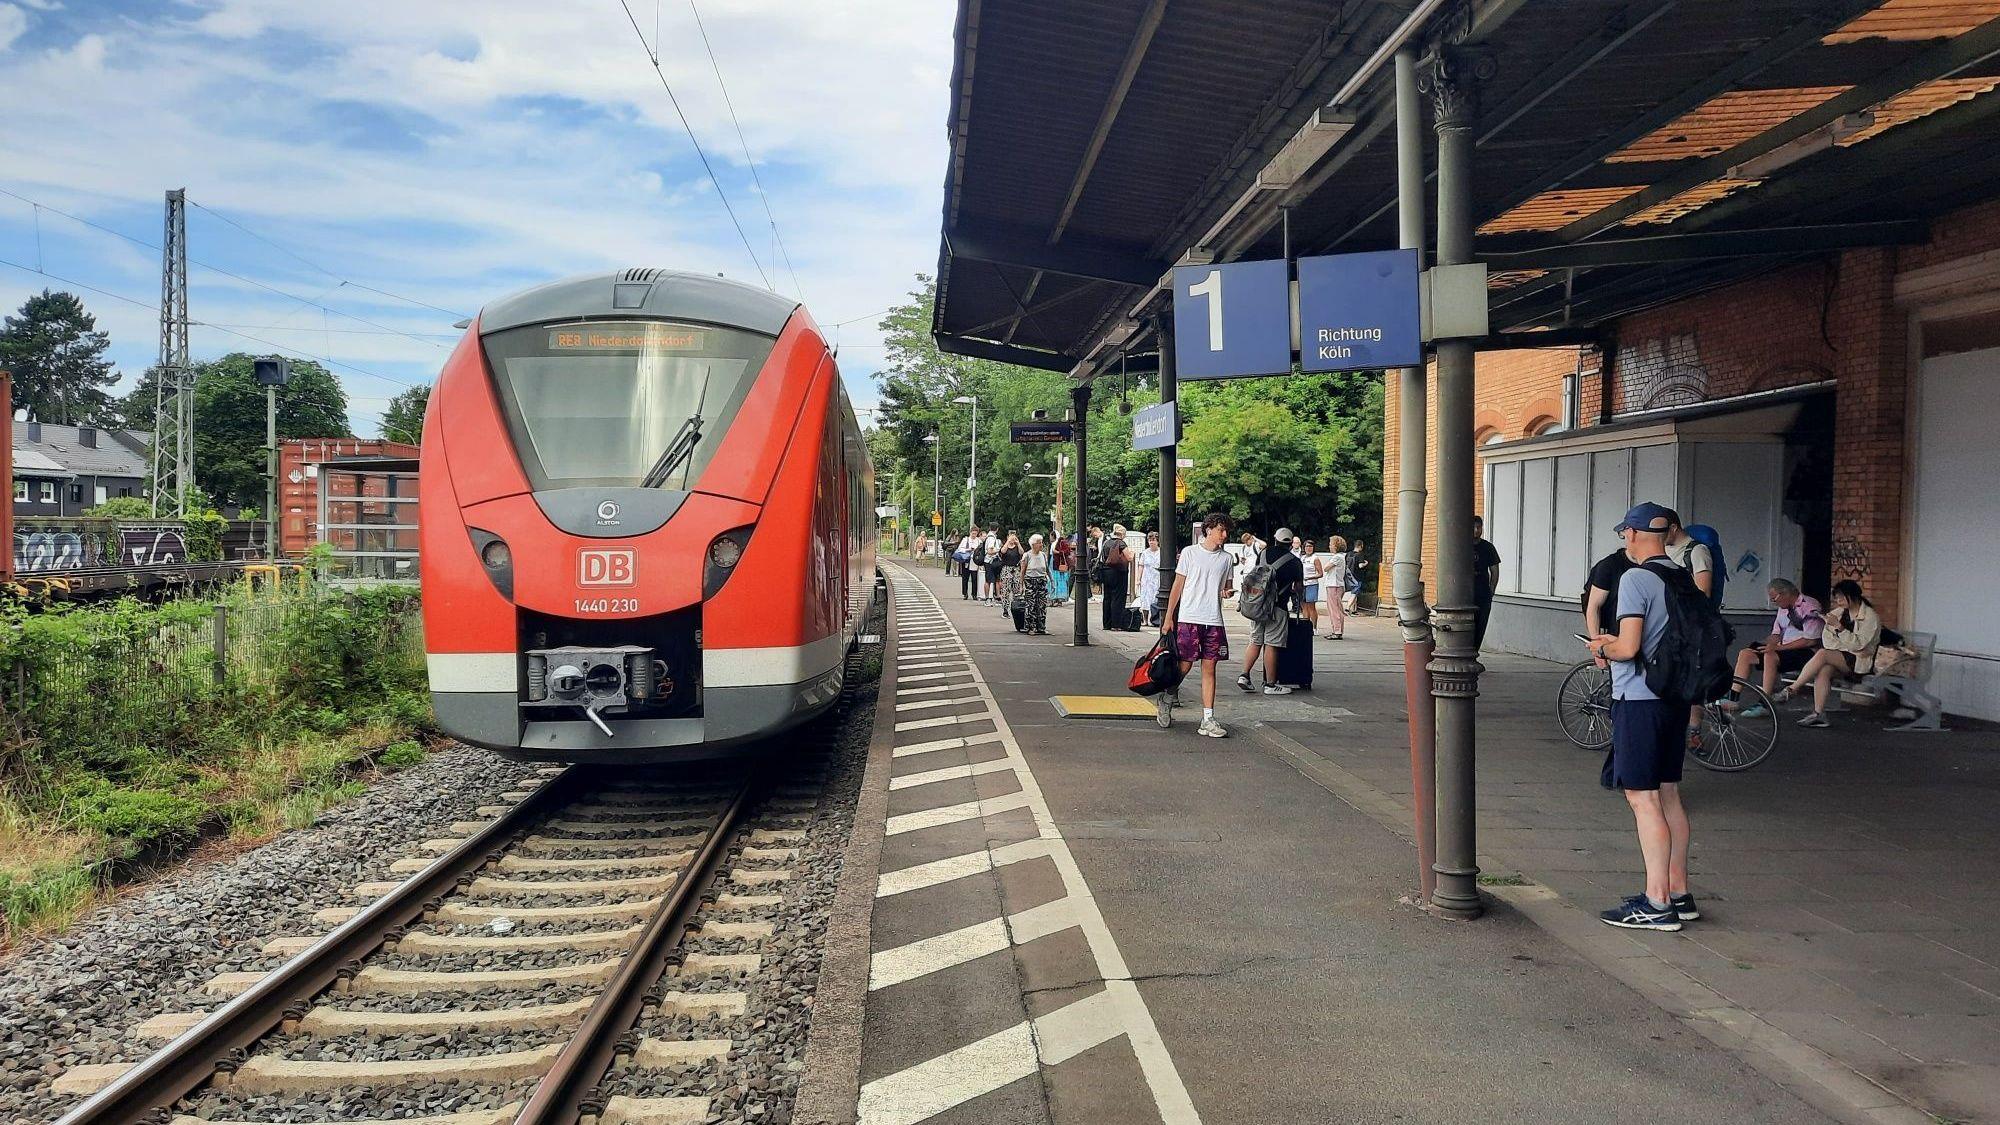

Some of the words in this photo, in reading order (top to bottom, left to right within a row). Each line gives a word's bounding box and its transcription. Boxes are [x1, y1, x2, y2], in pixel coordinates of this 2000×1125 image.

[1189, 270, 1223, 351] 1
[1318, 328, 1382, 342] Richtung
[1319, 346, 1351, 360] Köln
[584, 553, 630, 581] DB
[575, 599, 608, 613] 1440
[611, 599, 638, 612] 230
